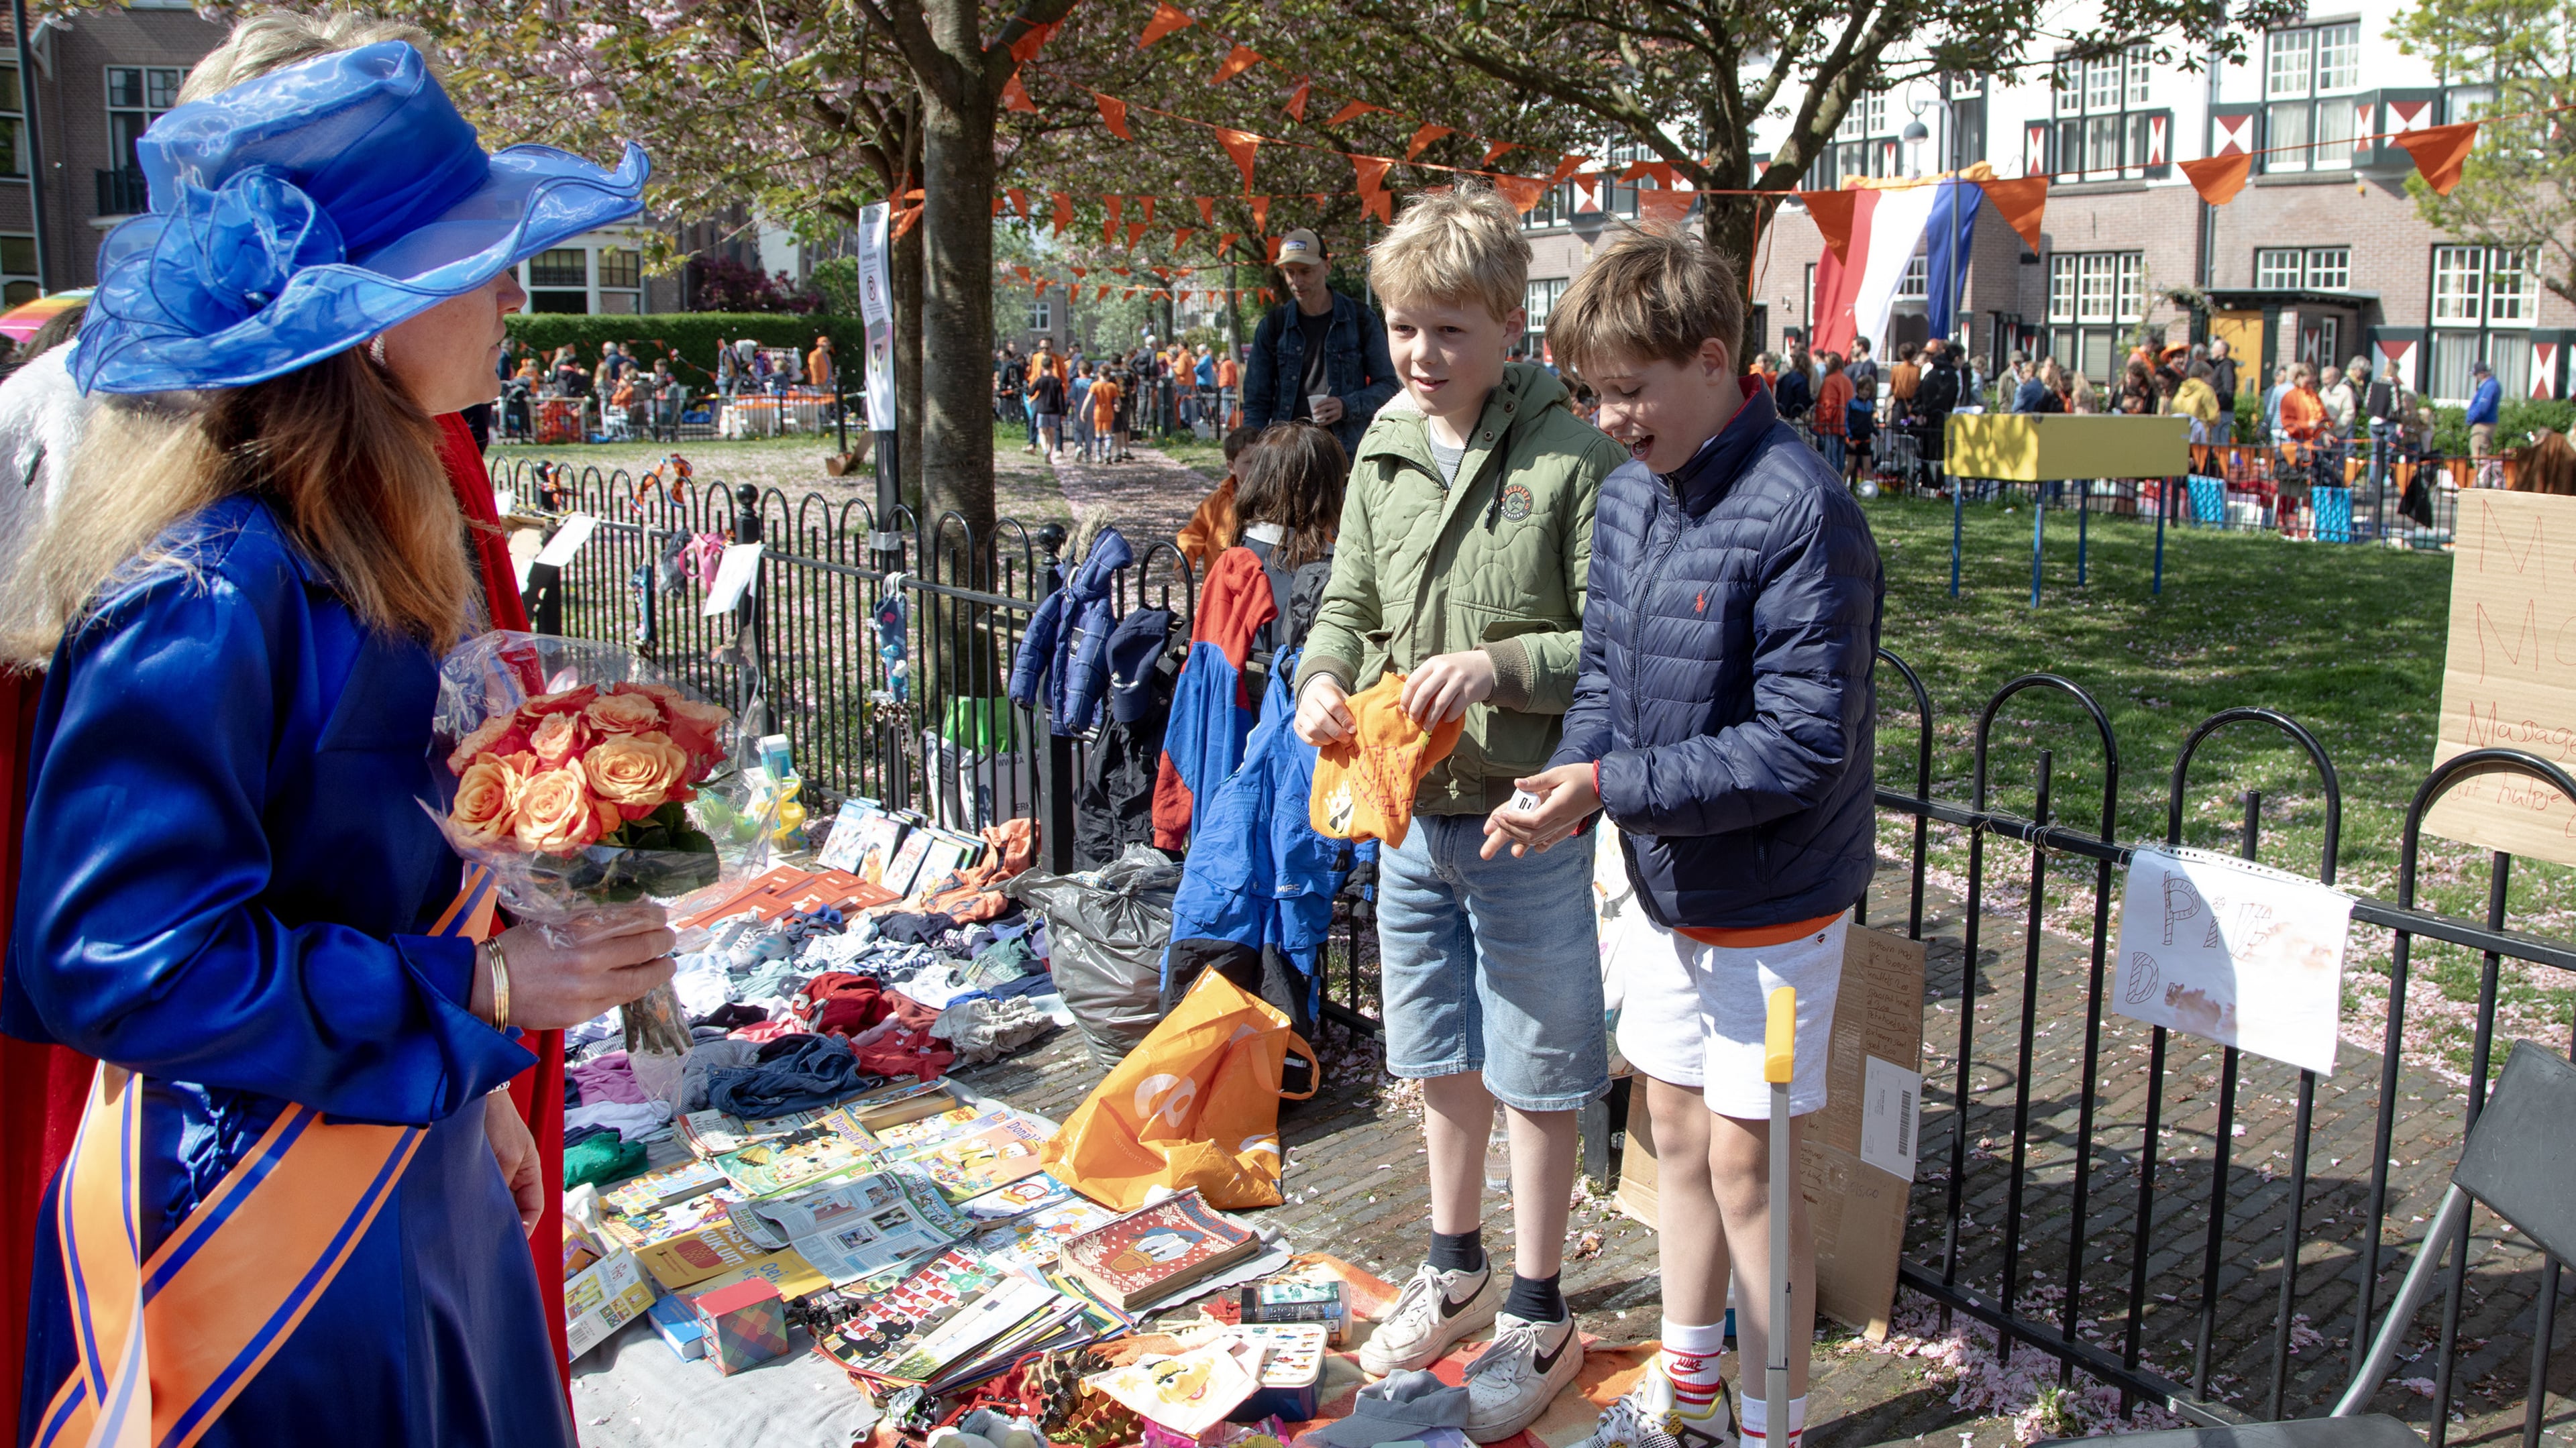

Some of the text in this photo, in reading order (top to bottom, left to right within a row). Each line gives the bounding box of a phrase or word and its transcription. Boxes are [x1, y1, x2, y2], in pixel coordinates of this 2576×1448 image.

[2479, 498, 2576, 594] M
[2498, 769, 2562, 811] hulpje
[1277, 884, 1300, 893] MPC
[828, 1114, 863, 1142] Donald
[1112, 1131, 1142, 1162] Samen
[740, 1208, 761, 1231] GROEN
[1177, 1196, 1245, 1243] Donald Duck
[696, 1227, 729, 1254] KIJK
[716, 1246, 745, 1267] UIT!
[739, 1241, 763, 1256] OP
[759, 1262, 789, 1284] Oei,
[1676, 1357, 1703, 1370] NIKE
